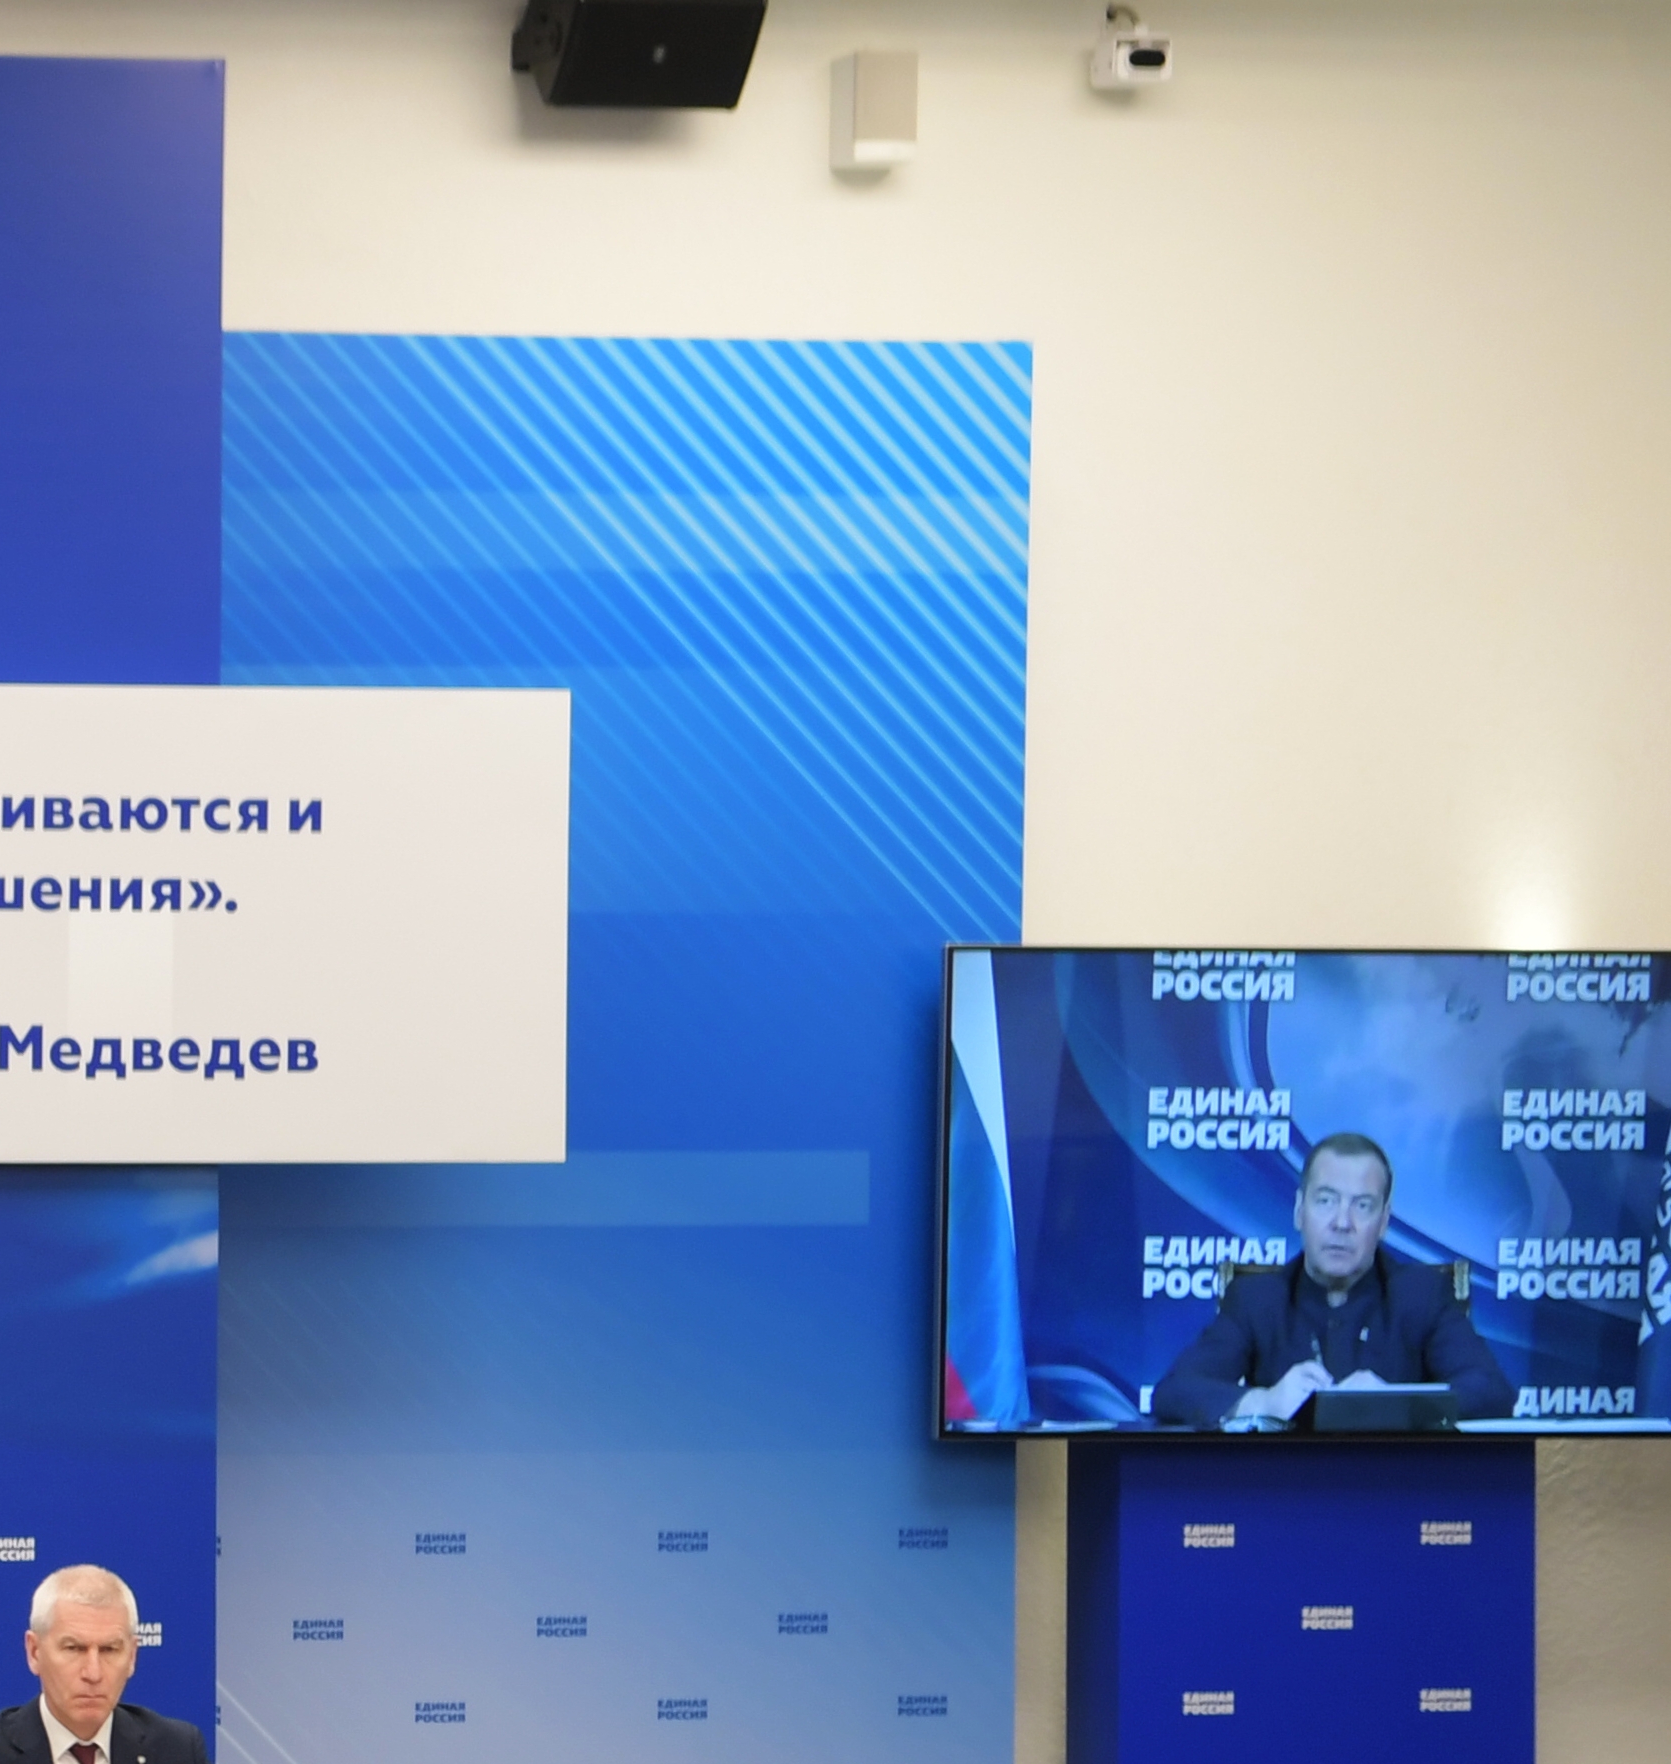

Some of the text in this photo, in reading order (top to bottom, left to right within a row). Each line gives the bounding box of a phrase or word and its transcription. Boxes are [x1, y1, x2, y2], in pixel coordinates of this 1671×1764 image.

[288, 799, 323, 833] и
[1152, 969, 1295, 1001] РОССИЯ
[1507, 971, 1651, 1001] РОССИЯ
[1148, 1086, 1291, 1119] ЕДИНАЯ
[1503, 1089, 1646, 1120] ЕДИНАЯ
[1146, 1118, 1290, 1150] РОССИЯ
[1501, 1120, 1645, 1151] РОССИЯ
[1498, 1237, 1642, 1269] ЕДИНАЯ
[1142, 1268, 1218, 1299] РОС
[1496, 1269, 1641, 1300] РОССИЯ
[1512, 1386, 1636, 1418] ДИНАЯ
[415, 1533, 467, 1544] ЕДИНАЯ
[657, 1531, 709, 1542] ЕДИНАЯ
[898, 1527, 950, 1539] ЕДИНАЯ
[415, 1543, 467, 1555] РОССИЯ
[657, 1541, 709, 1553] РОССИЯ
[898, 1538, 949, 1550] РОССИЯ
[292, 1619, 344, 1630] ЕДИНАЯ
[536, 1616, 588, 1627] ЕДИНАЯ
[777, 1613, 829, 1624] ЕДИНАЯ
[136, 1623, 162, 1634] НАЯ
[536, 1626, 588, 1638] РОССИЯ
[777, 1623, 829, 1635] РОССИЯ
[137, 1635, 162, 1647] СИЯ
[292, 1629, 344, 1641] РОССИЯ
[657, 1698, 708, 1710] ЕДИНАЯ
[897, 1695, 948, 1706] ЕДИНАЯ
[414, 1702, 466, 1713] ЕДИНАЯ
[897, 1705, 948, 1717] РОССИЯ
[414, 1712, 466, 1724] РОССИЯ
[657, 1709, 709, 1721] РОССИЯ
